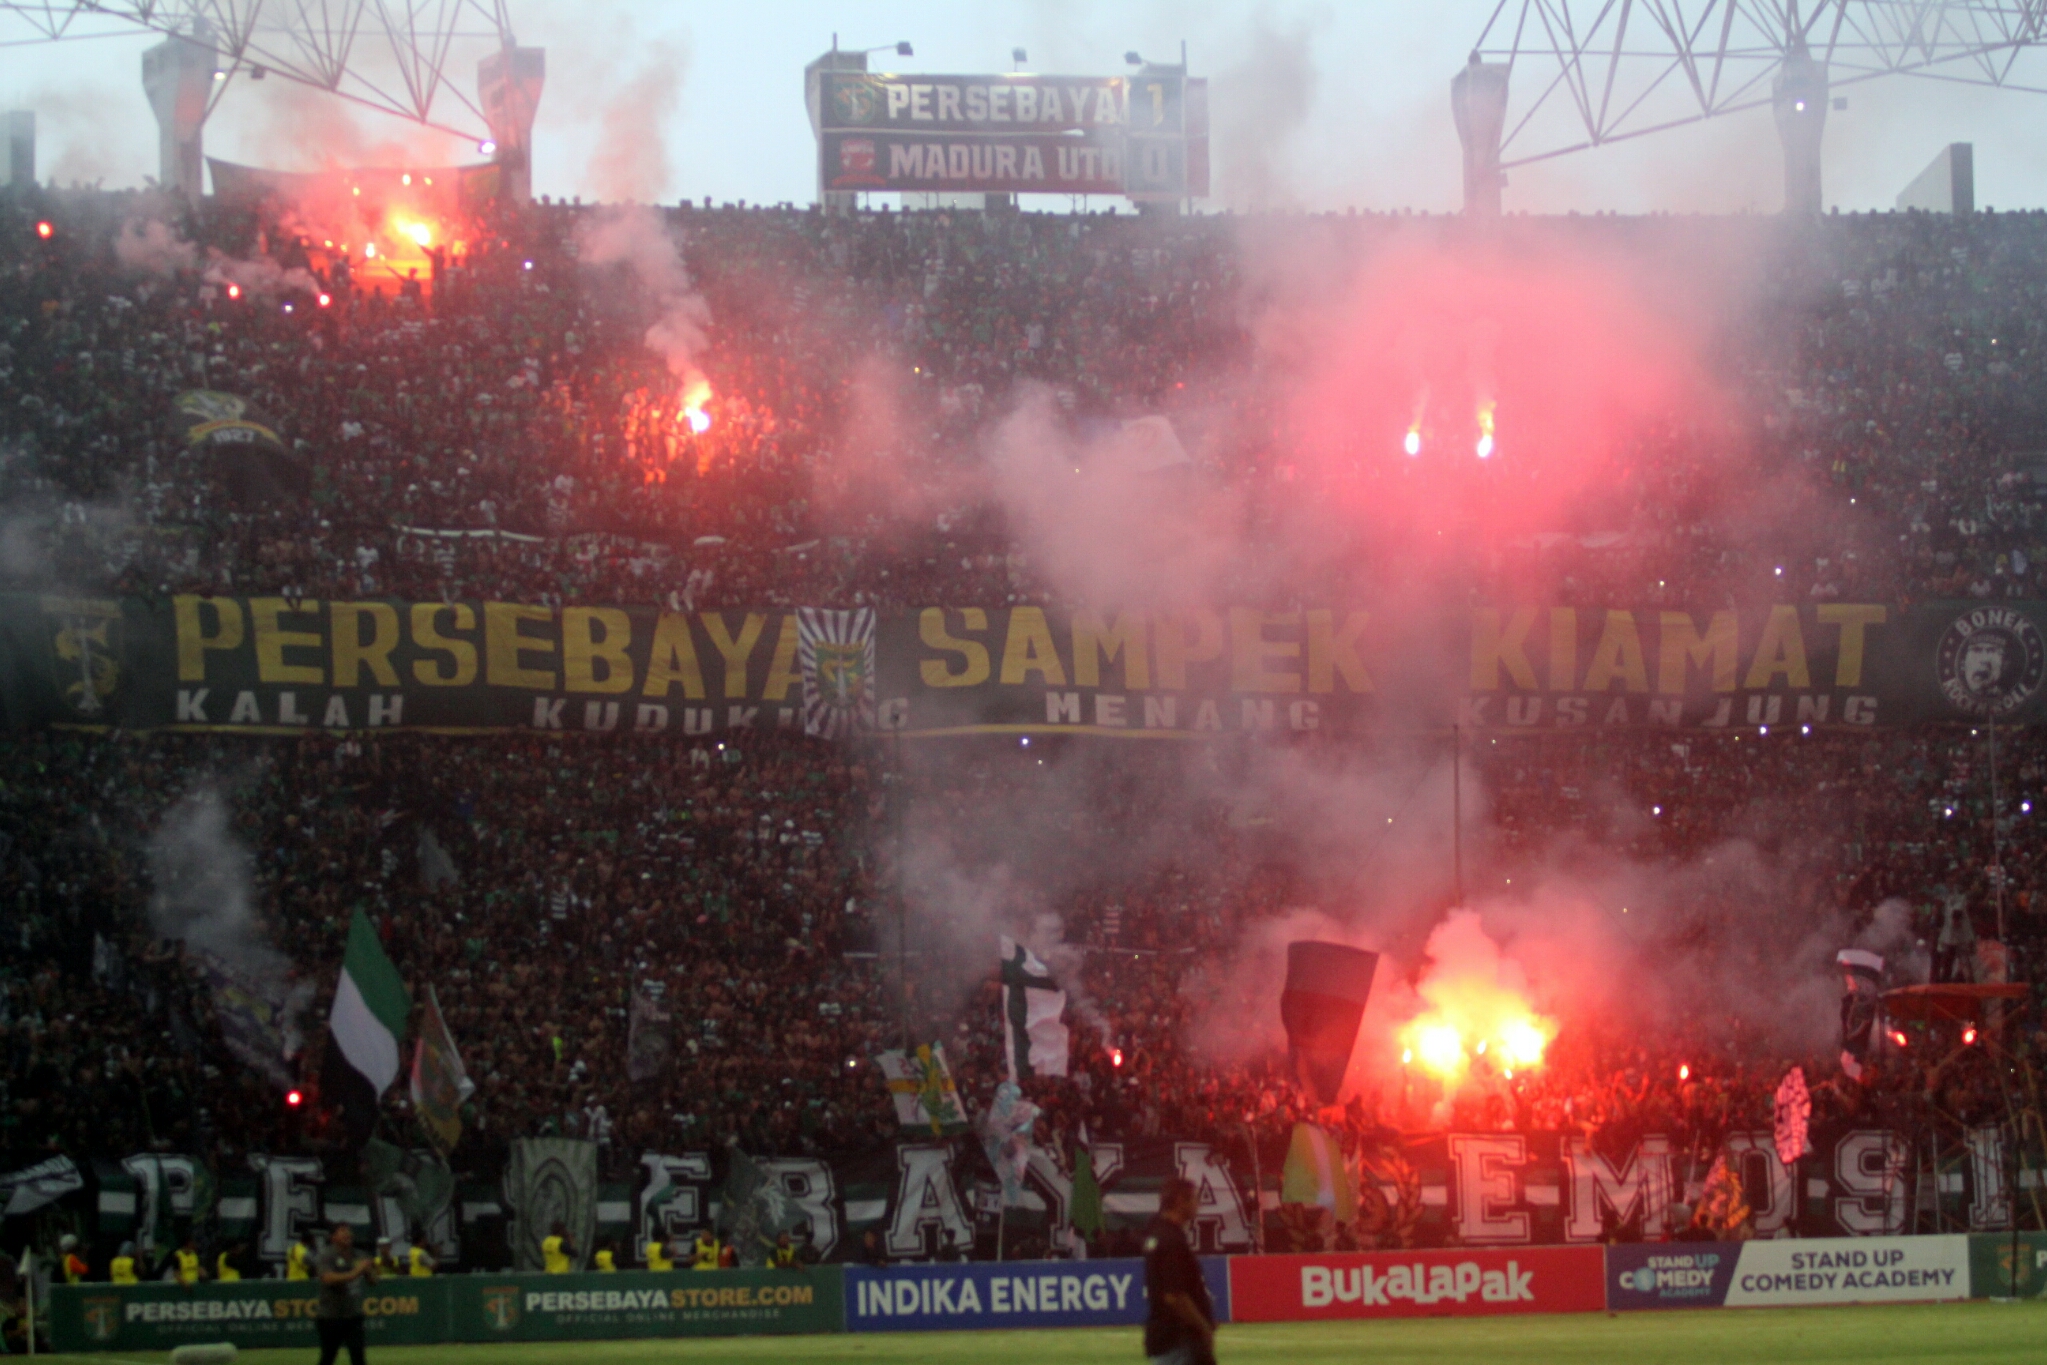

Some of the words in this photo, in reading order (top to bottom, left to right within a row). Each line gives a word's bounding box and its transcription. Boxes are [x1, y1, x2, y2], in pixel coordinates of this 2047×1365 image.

[884, 83, 1117, 124] PERSEBAYA
[1146, 82, 1164, 126] 1
[888, 144, 1046, 181] MADURA
[1056, 145, 1122, 182] UTD
[1955, 609, 2031, 637] BONEK
[172, 594, 805, 700] PERSEBAYA
[917, 604, 1374, 694] SAMPEK
[1468, 602, 1887, 694] KIAMAT
[175, 689, 405, 728] KALAH
[532, 696, 909, 736] KUDUKUG
[1045, 691, 1319, 731] MENANG
[1647, 1254, 1693, 1269] STAND
[1694, 1253, 1720, 1268] UP
[1791, 1250, 1870, 1270] STAND
[1873, 1249, 1905, 1268] UP
[857, 1277, 982, 1317] INDIKA
[990, 1273, 1133, 1313] ENERGY
[1658, 1286, 1712, 1299] ACADEMY
[1740, 1272, 1838, 1293] COMEDY
[1842, 1269, 1956, 1289] ACADEMY
[126, 1295, 419, 1323] PERSEBAYASTOCOM
[628, 1310, 676, 1323] ONLINE
[682, 1308, 781, 1321] MERCHANDISE
